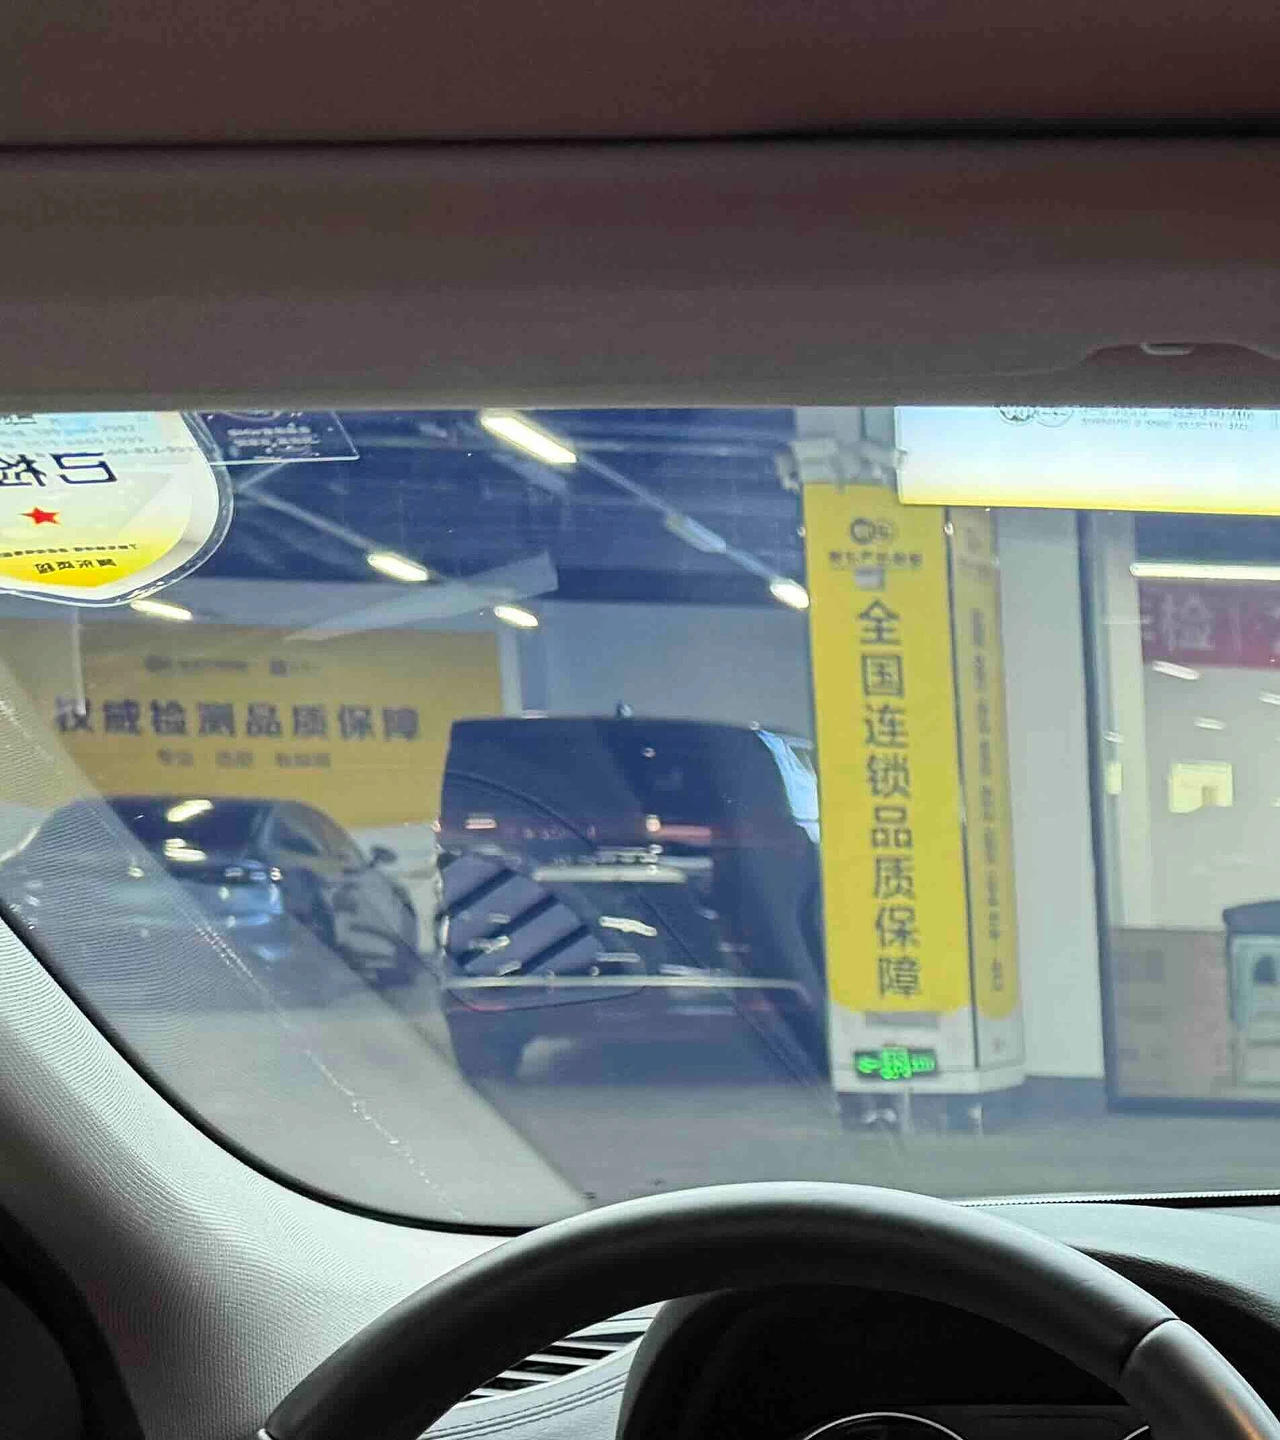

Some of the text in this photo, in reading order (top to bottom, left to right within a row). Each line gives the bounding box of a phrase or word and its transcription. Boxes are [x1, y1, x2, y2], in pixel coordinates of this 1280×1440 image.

[55, 696, 419, 743] 权威检测品质保障
[857, 599, 921, 996] 全国连锁品质保障
